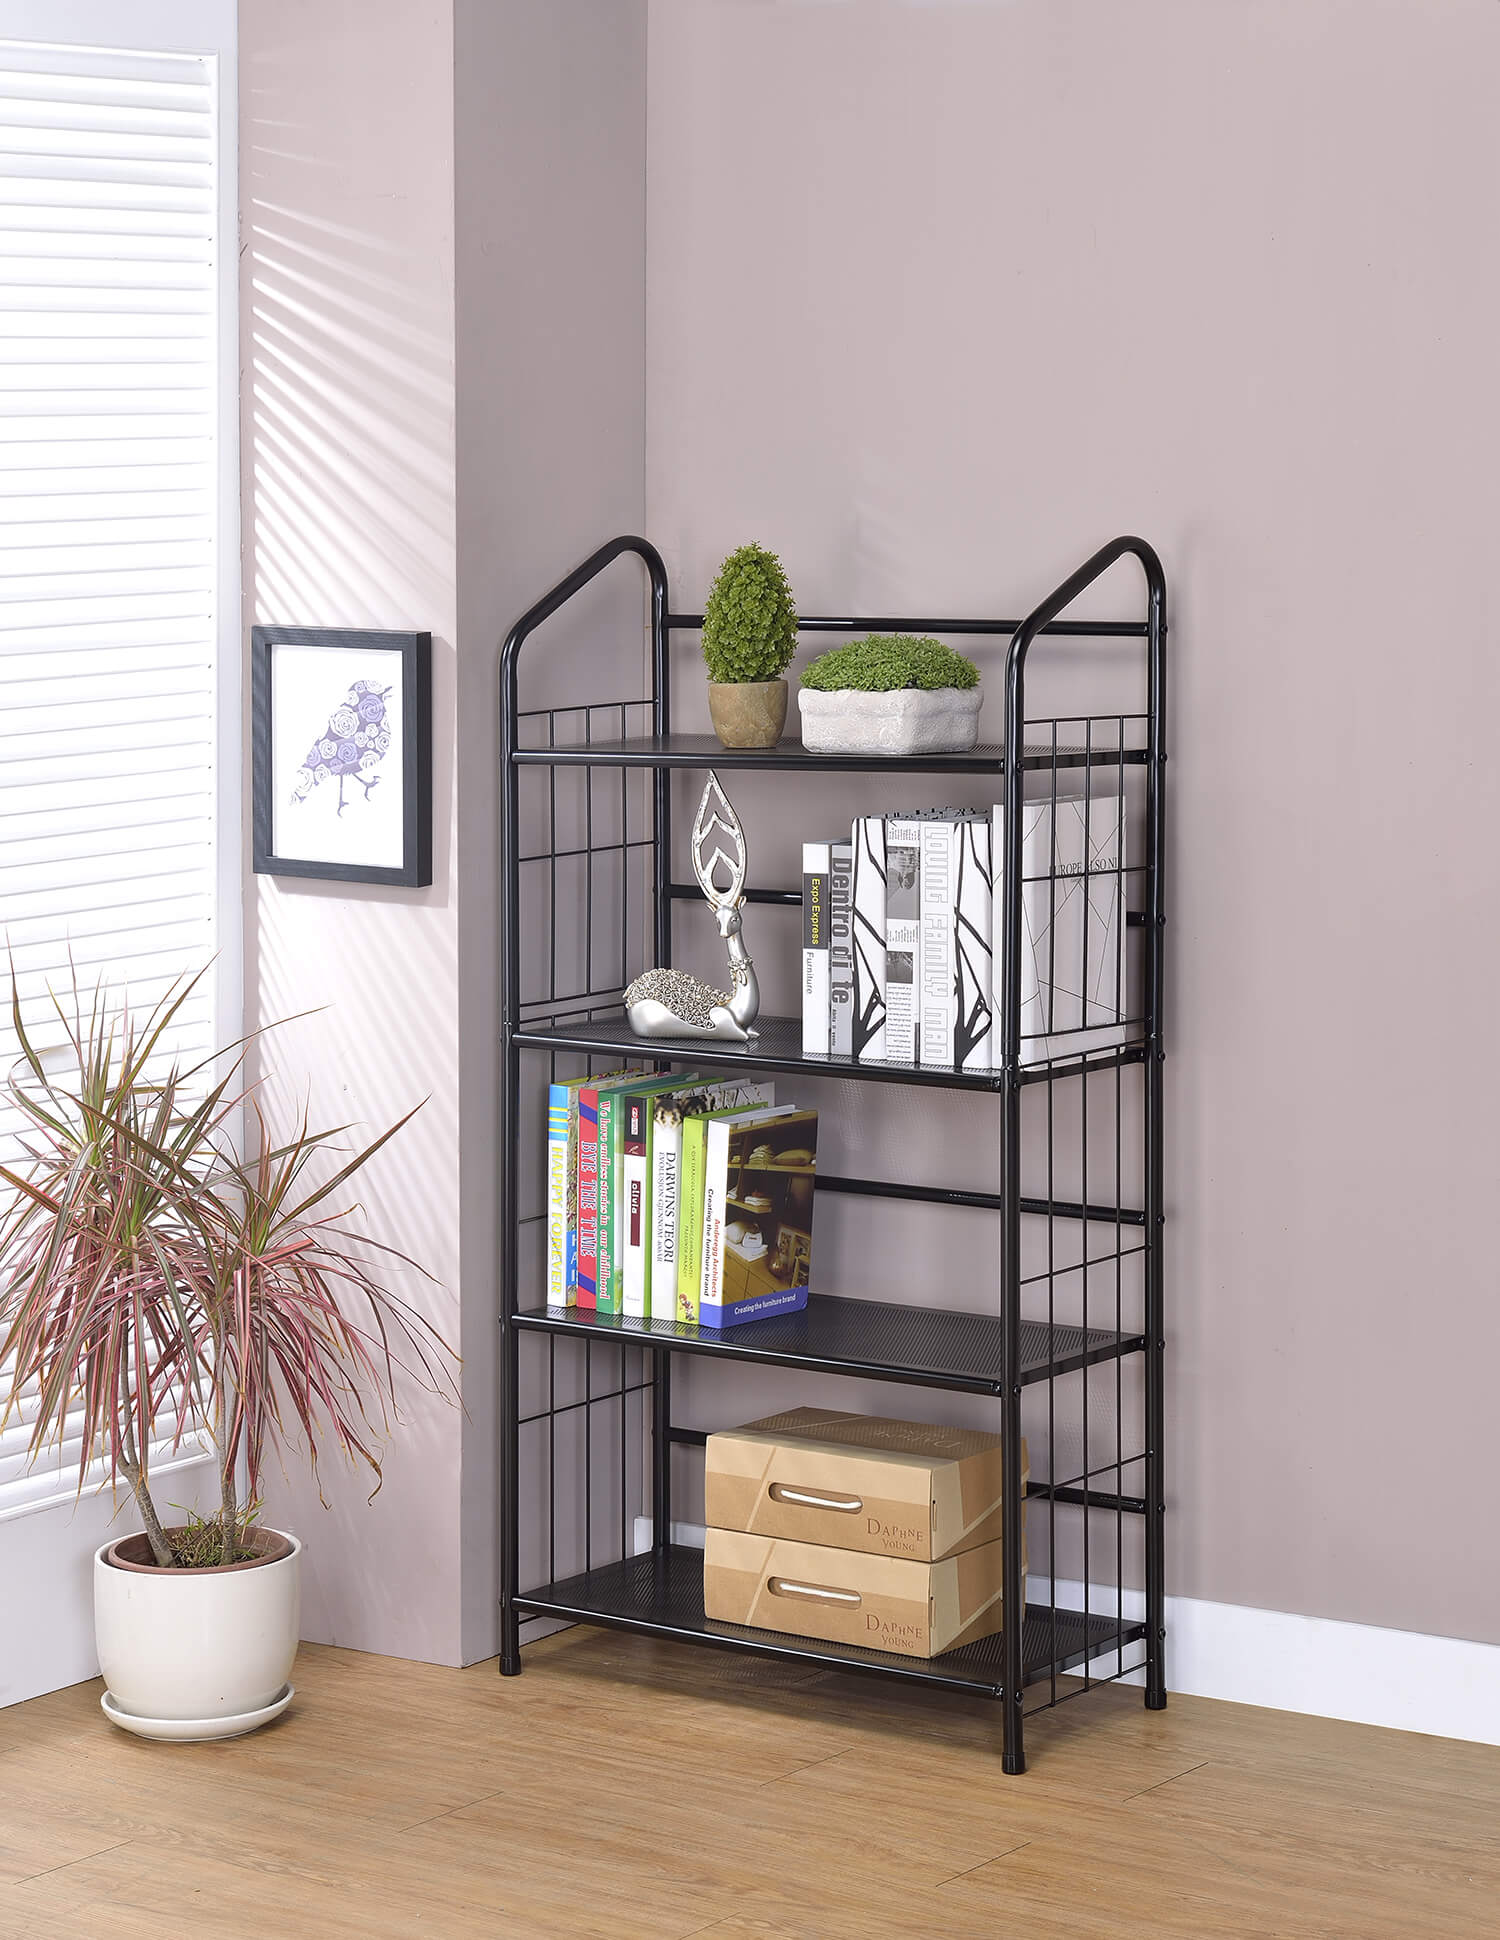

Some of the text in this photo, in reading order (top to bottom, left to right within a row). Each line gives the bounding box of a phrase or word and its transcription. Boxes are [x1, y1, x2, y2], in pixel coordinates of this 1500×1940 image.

[810, 878, 821, 945] Expo Express
[832, 857, 853, 1004] Dentro di te
[806, 952, 814, 995] Furniture
[600, 1117, 611, 1141] have
[600, 1143, 611, 1179] endless
[580, 1141, 597, 1257] BYE THE TIME
[600, 1180, 611, 1213] stories
[631, 1182, 639, 1214] olivia
[664, 1152, 676, 1263] DARWINS TEORI
[705, 1188, 714, 1222] Creating
[551, 1147, 563, 1295] HAPPY FOREVER
[600, 1215, 610, 1225] in
[600, 1229, 608, 1248] our
[704, 1238, 712, 1271] furniture
[600, 1249, 611, 1299] childhood
[711, 1219, 721, 1298] Anderegg Architects
[703, 1273, 711, 1296] brand
[734, 1293, 797, 1315] Creating the furniture brand
